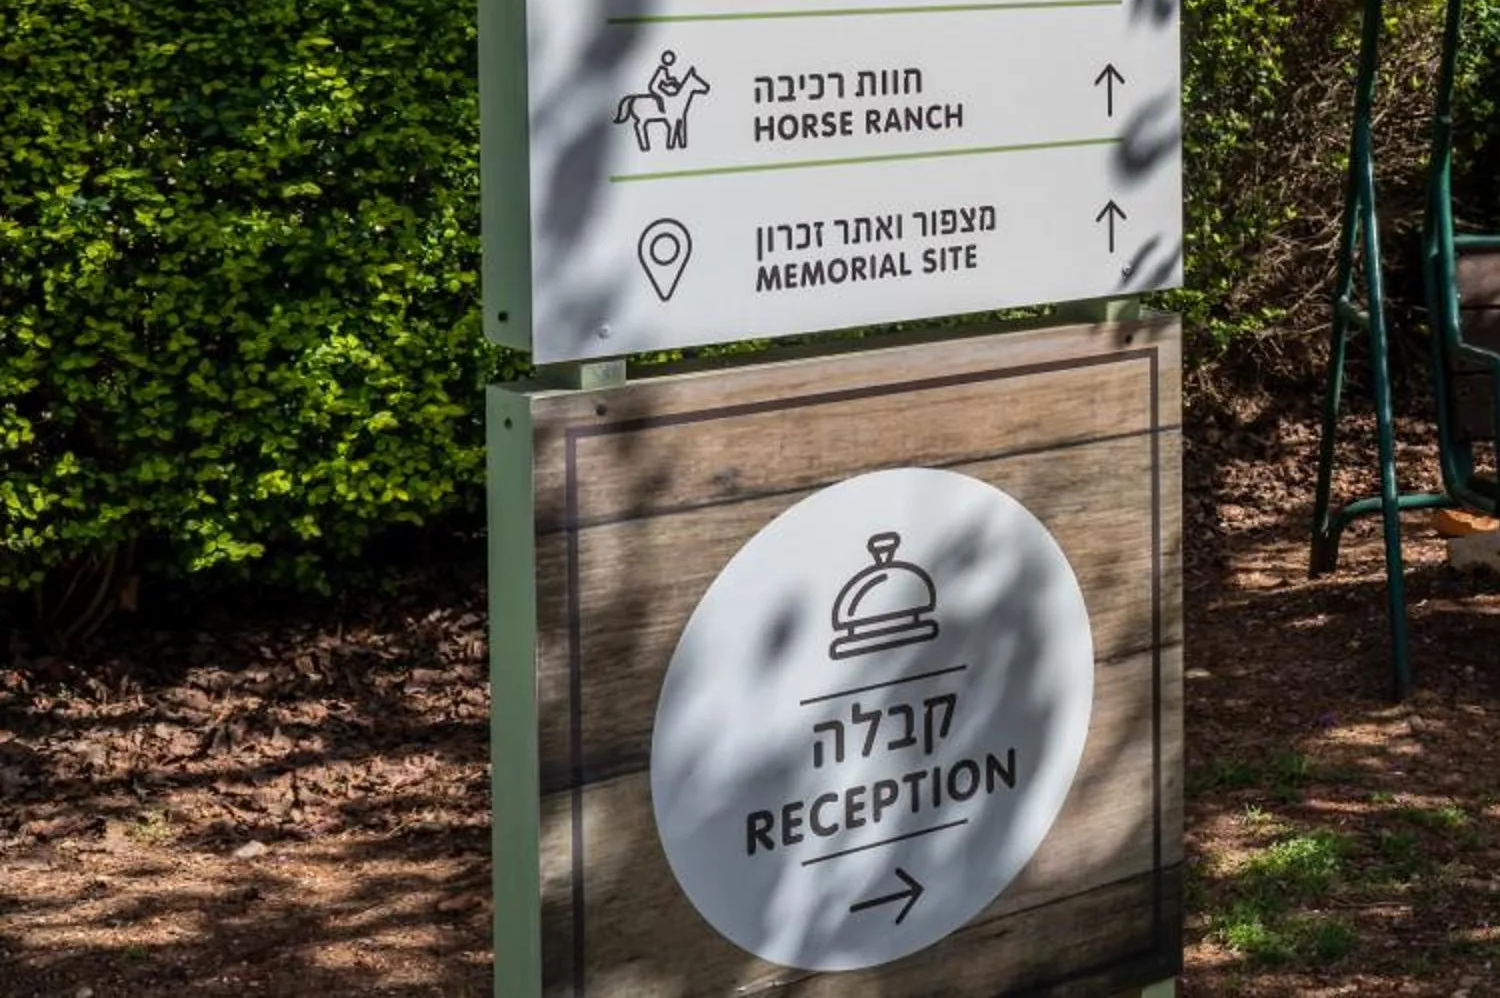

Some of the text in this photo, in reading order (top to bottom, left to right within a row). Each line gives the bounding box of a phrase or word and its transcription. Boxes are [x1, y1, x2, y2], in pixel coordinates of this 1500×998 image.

[754, 68, 923, 103] חוות רכיבה
[754, 103, 963, 142] HORSE RANCH
[756, 205, 996, 262] מצפור ואתר זכרון
[755, 244, 977, 292] MEMORIAL SITE
[813, 693, 957, 768] קבלה
[746, 747, 1016, 856] RECEPTION
